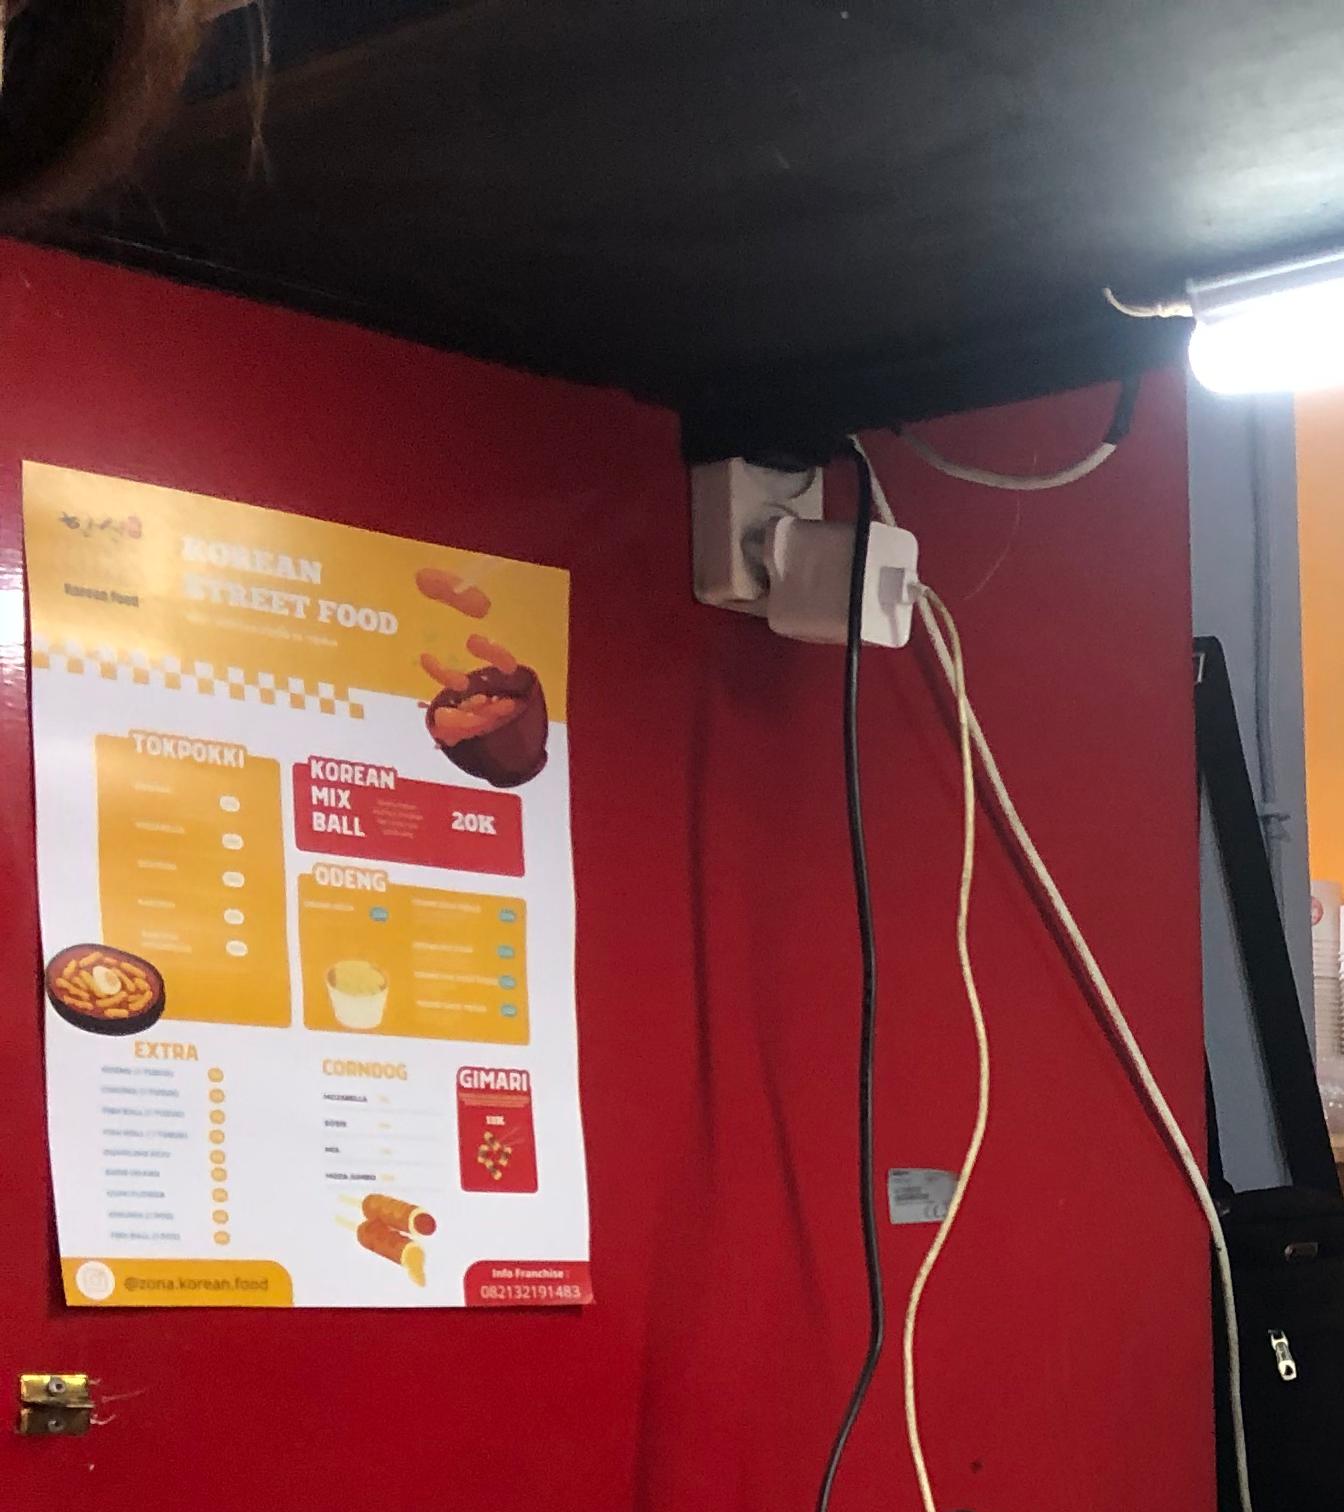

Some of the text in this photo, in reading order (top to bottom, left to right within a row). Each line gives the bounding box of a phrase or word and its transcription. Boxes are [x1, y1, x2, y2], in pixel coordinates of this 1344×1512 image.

[182, 534, 322, 585] KOREAN
[182, 571, 310, 619] STREET
[318, 599, 400, 636] FOOD
[131, 732, 246, 770] TOKPOKKI
[310, 758, 397, 791] KOREAN
[311, 785, 352, 811] MIX
[312, 810, 367, 838] BALL
[451, 810, 498, 836] 20K
[314, 865, 388, 893] ODENG
[133, 1039, 200, 1062] EXTRA
[322, 1058, 408, 1082] CORNDOG
[460, 1068, 528, 1093] GIMARI
[491, 1267, 565, 1280] Info Franchise
